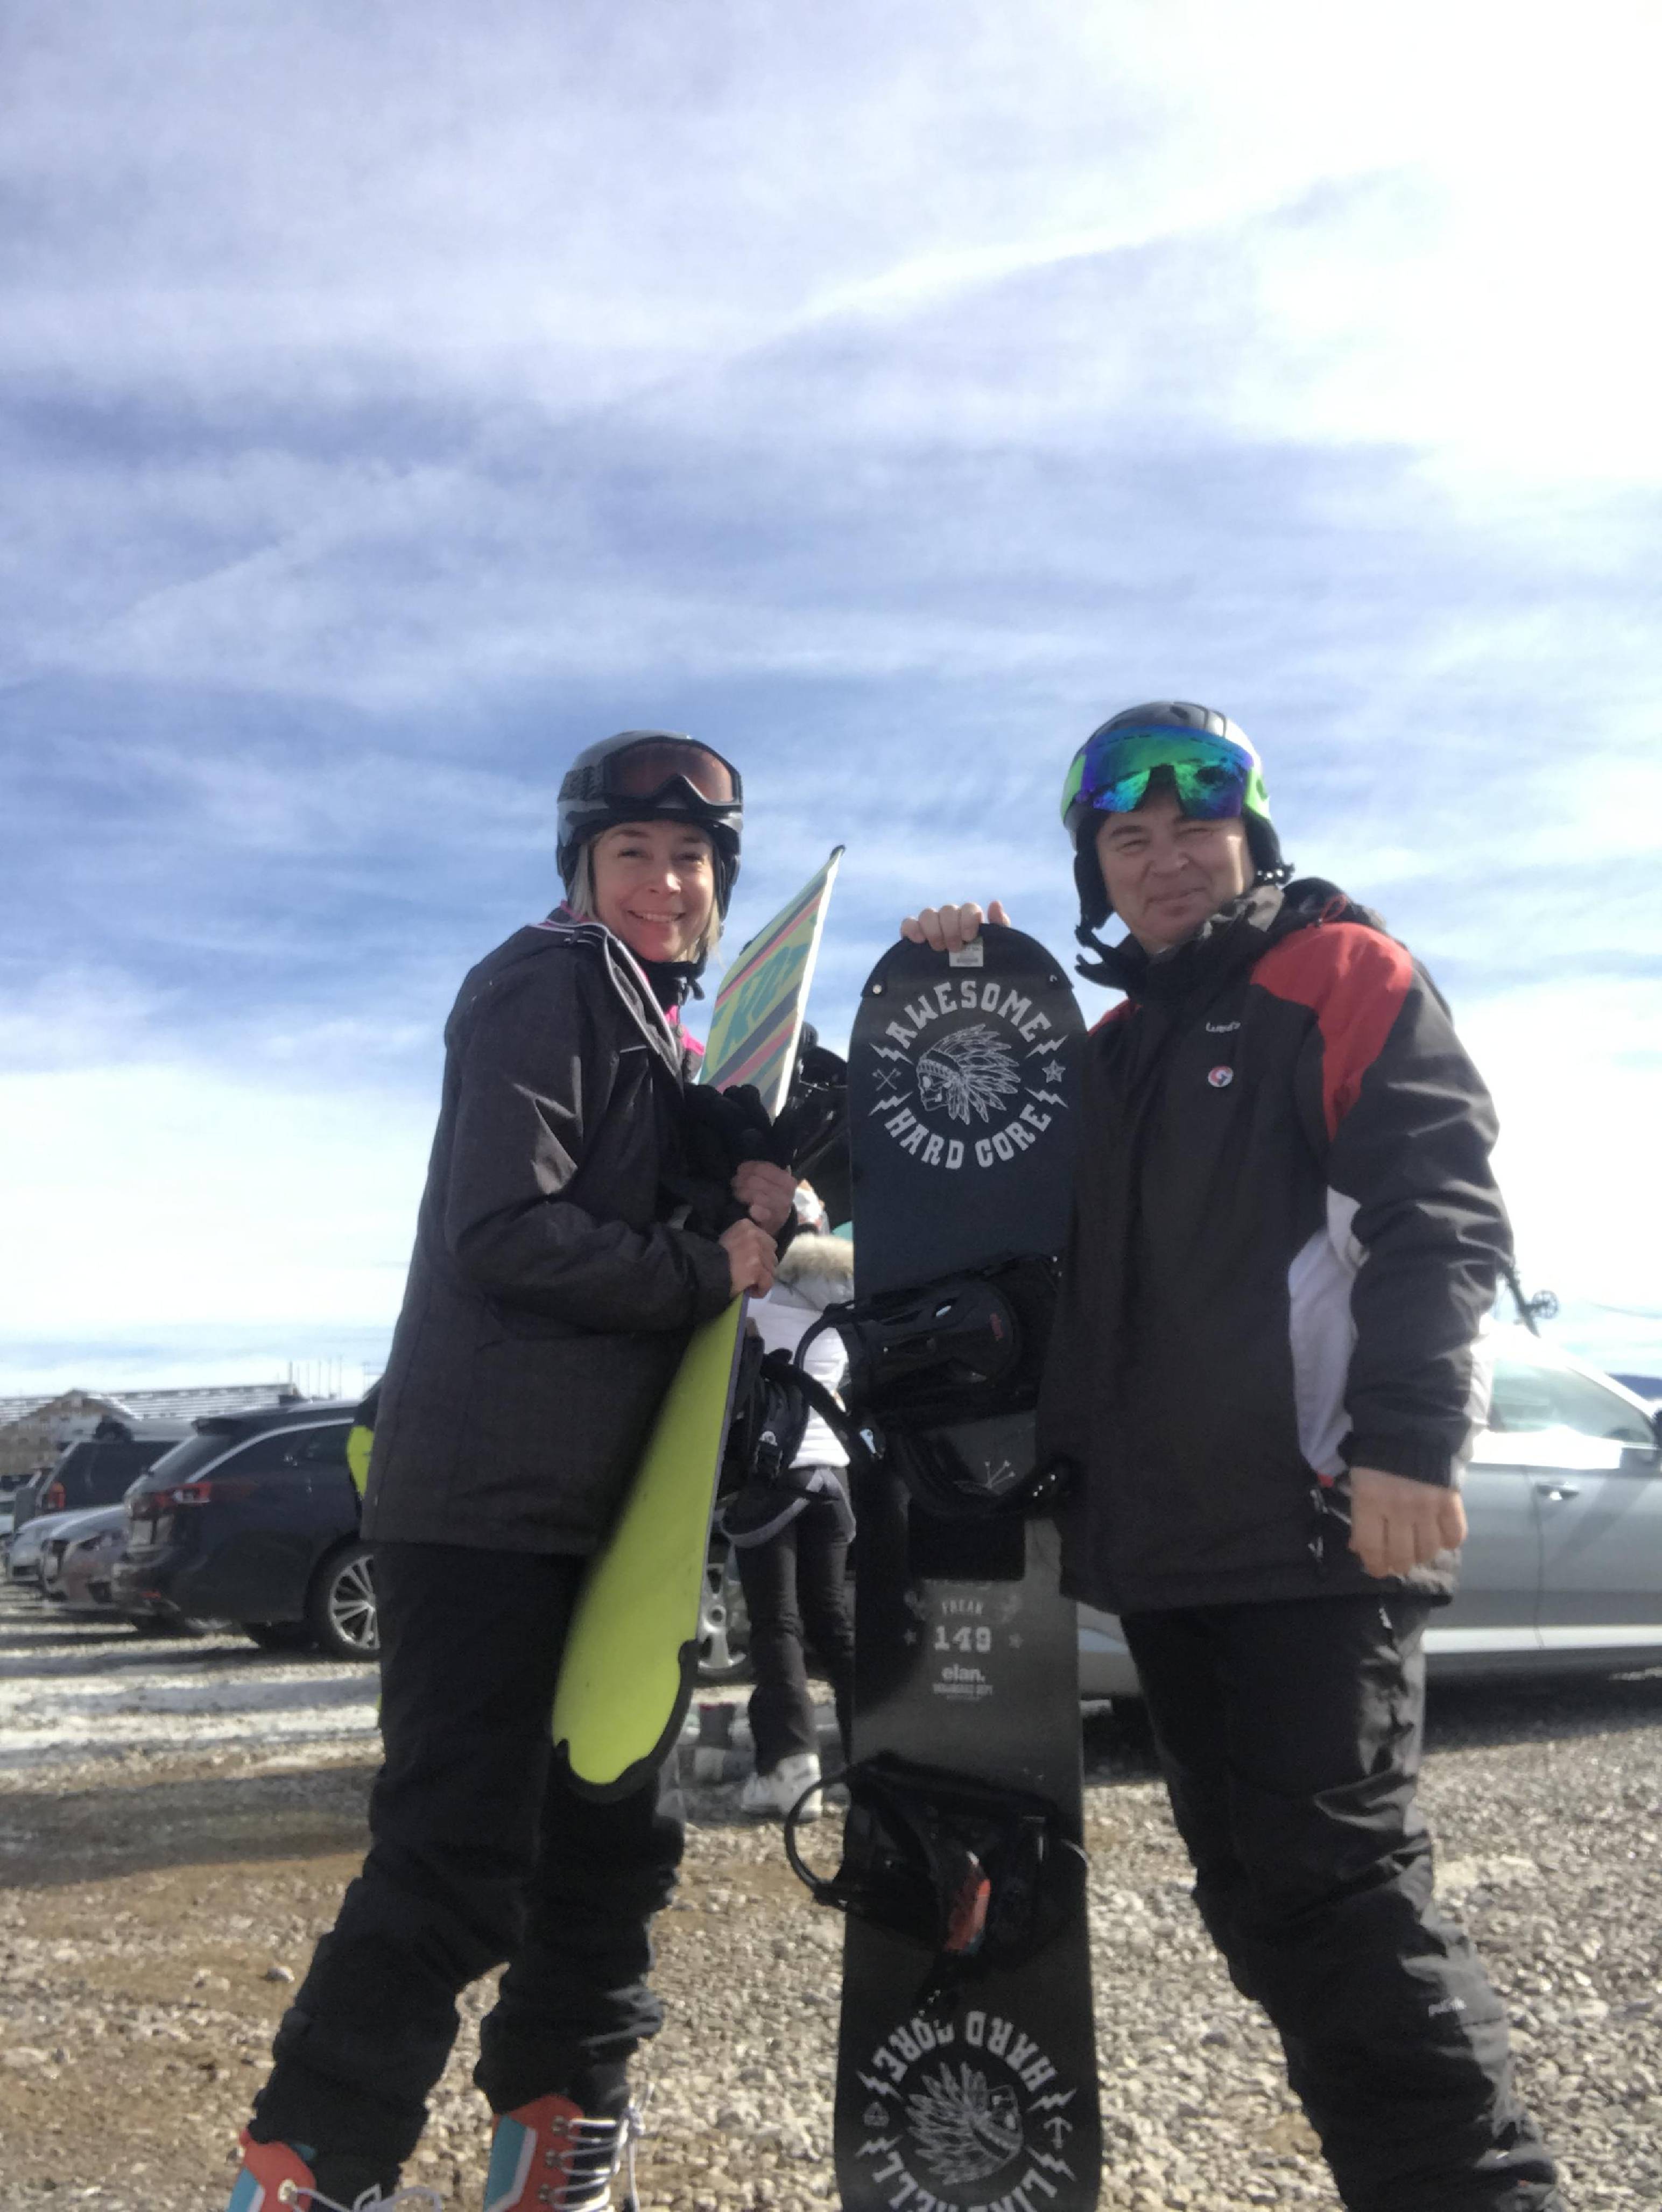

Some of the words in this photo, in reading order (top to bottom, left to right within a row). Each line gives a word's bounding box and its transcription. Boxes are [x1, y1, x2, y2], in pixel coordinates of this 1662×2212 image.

[885, 980, 1053, 1049] AWESOME
[884, 1107, 964, 1170] HARD
[975, 1104, 1052, 1168] CORE
[934, 1625, 992, 1653] 149
[966, 2011, 1058, 2092] HARD
